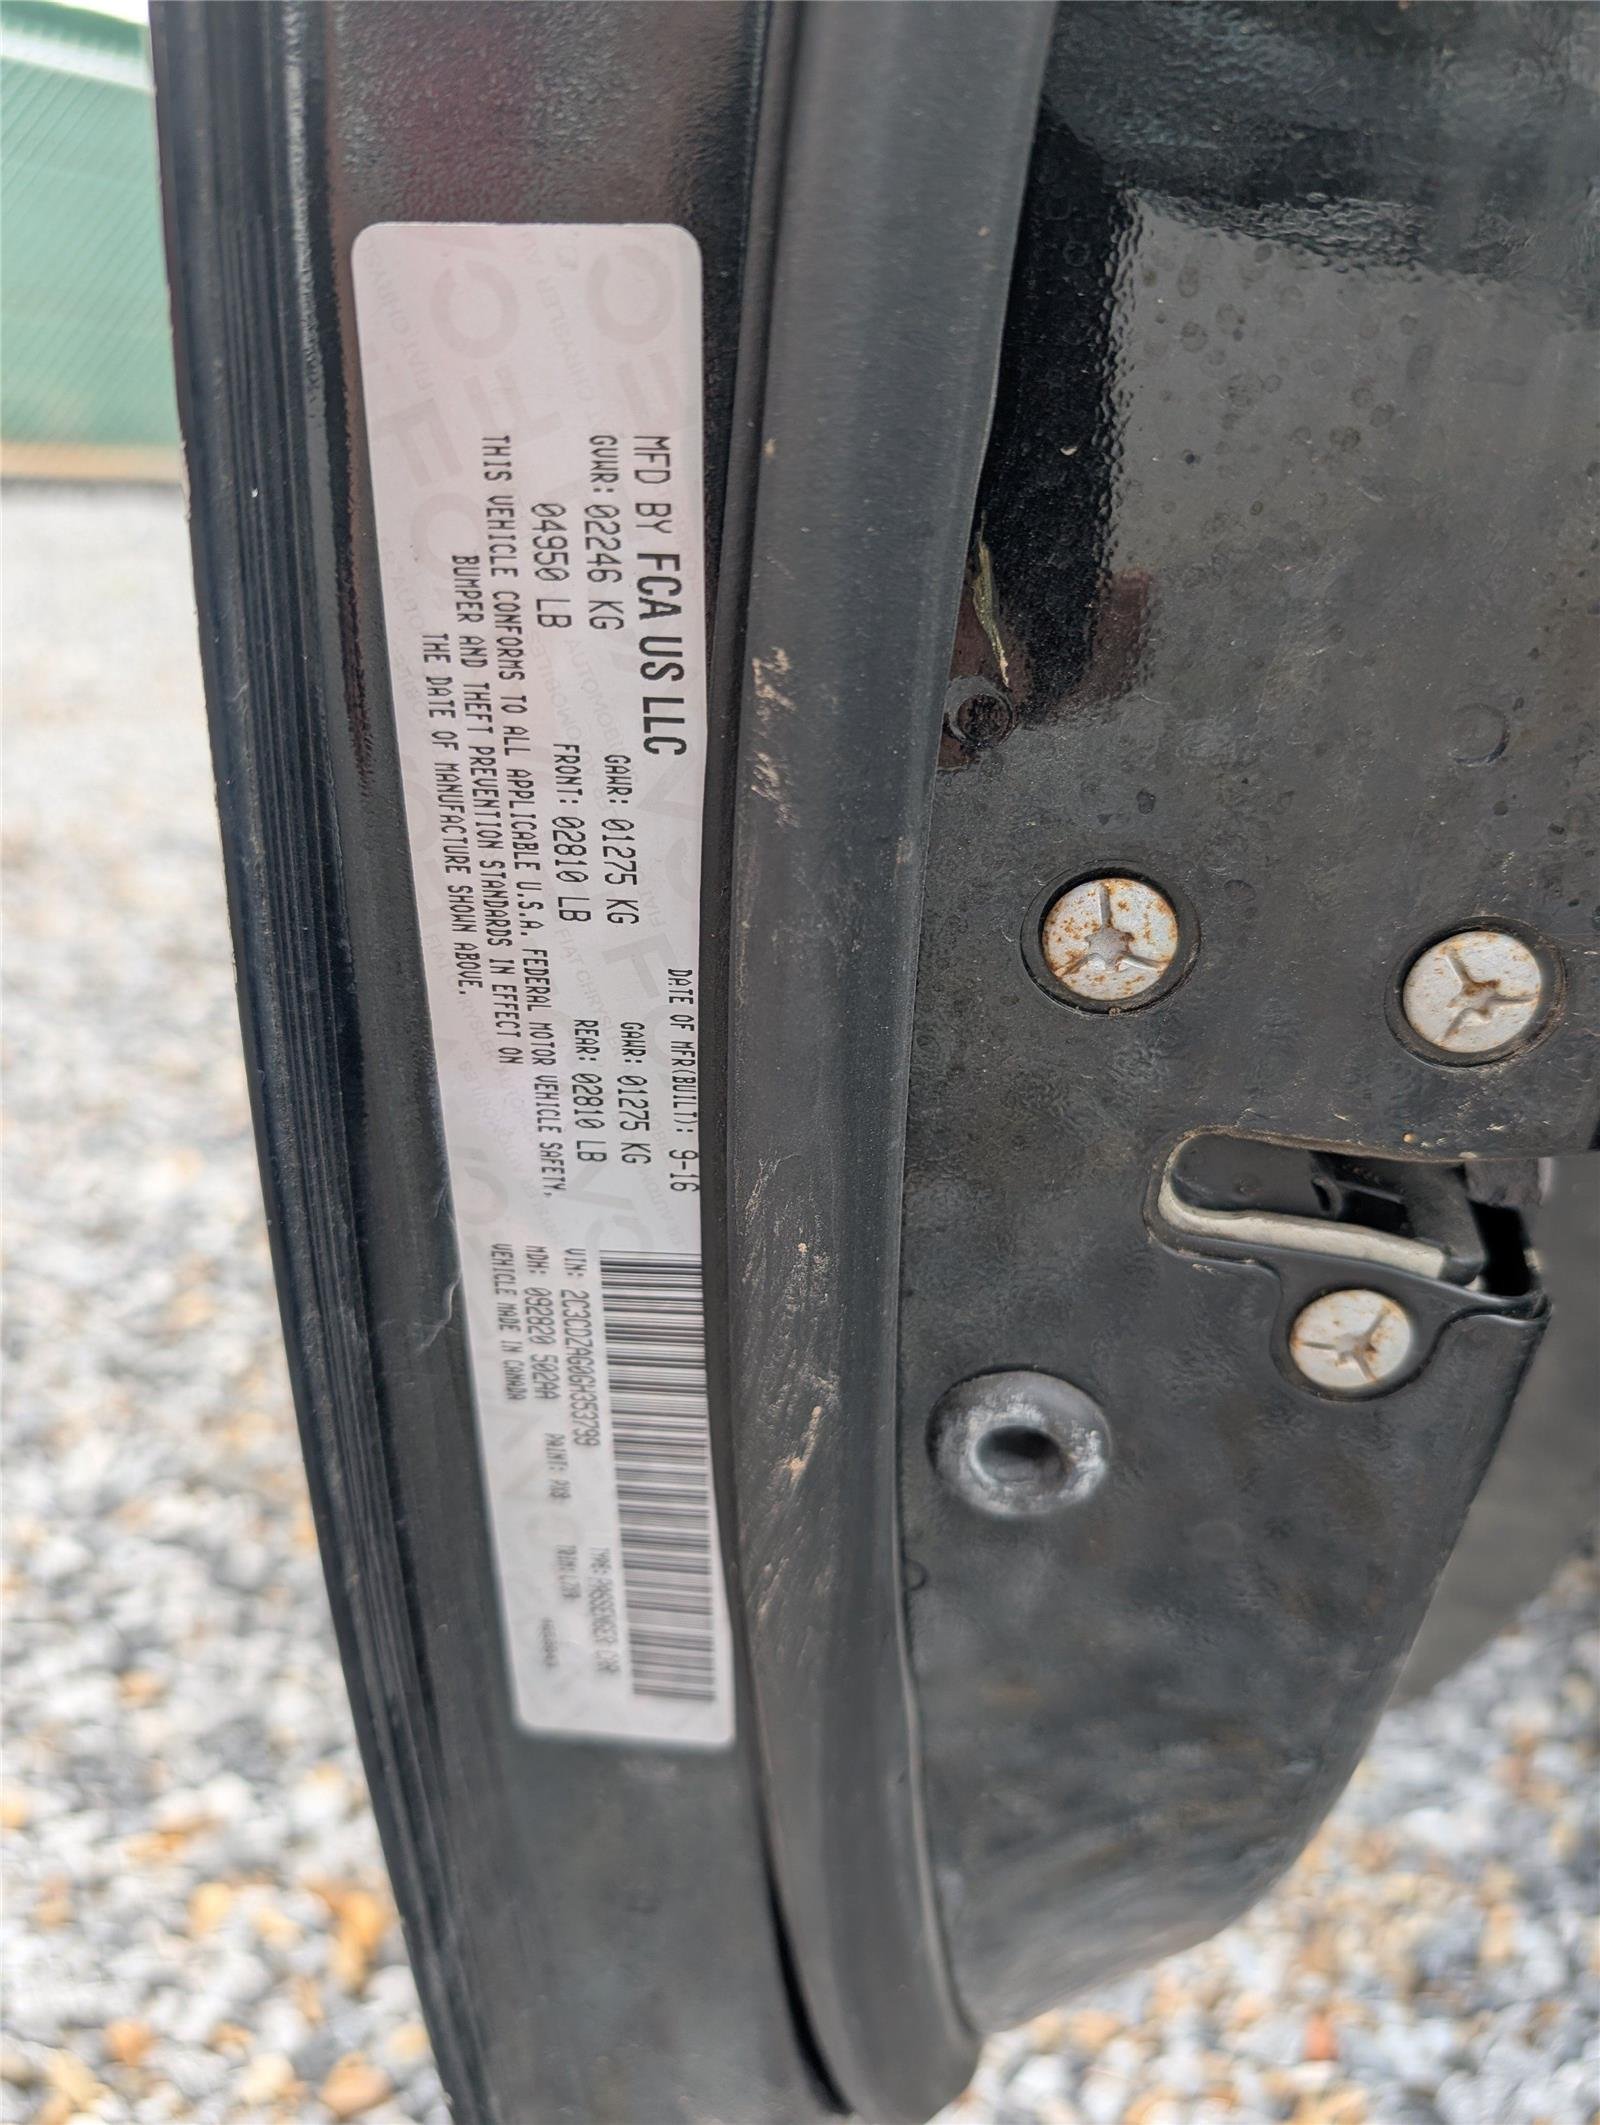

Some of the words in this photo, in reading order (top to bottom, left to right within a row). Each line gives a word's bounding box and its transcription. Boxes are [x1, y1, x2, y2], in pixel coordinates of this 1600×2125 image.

[481, 435, 510, 481] THIS
[589, 435, 618, 494] GVWR:
[633, 435, 670, 484] MFD
[486, 495, 517, 577] VEHICLE
[530, 503, 569, 582] 04950
[635, 503, 671, 534] BY
[583, 504, 621, 583] 02246
[451, 555, 482, 622] BUMPER
[636, 552, 682, 620] FCA
[493, 590, 526, 680] CONFORMS
[536, 599, 571, 628] LB
[588, 600, 624, 630] KG
[421, 633, 449, 663] THE
[459, 635, 487, 668] AND
[639, 636, 684, 681] US
[424, 676, 452, 718] DATE
[463, 682, 494, 734] THEFT
[499, 695, 526, 714] TO
[430, 731, 457, 751] OF
[502, 726, 529, 756] ALL
[643, 696, 686, 756] LLC
[468, 746, 503, 849] PREVENTION
[552, 744, 583, 804] FRONT:
[603, 755, 633, 805] GAWR:
[433, 762, 470, 874] MANUFACTURE
[505, 769, 539, 870] APPLICABLE
[551, 816, 586, 883] 02810
[601, 818, 637, 885] 01275
[446, 885, 475, 932] SHOWN
[479, 860, 512, 946] STANDARDS
[514, 882, 542, 936] U.S.A.
[557, 896, 590, 922] LB
[606, 898, 639, 925] KG
[453, 943, 483, 995] ABOVE.
[488, 958, 514, 974] IN
[522, 949, 552, 1012] FEDERAL
[667, 969, 693, 1004] DATE
[491, 983, 521, 1038] EFFECT
[669, 1014, 694, 1031] OF
[497, 1047, 523, 1064] ON
[529, 1022, 555, 1065] MOTOR
[573, 1020, 598, 1062] REAR:
[619, 1022, 646, 1064] GAWR:
[534, 1075, 562, 1133] VEHICLE
[571, 1073, 603, 1129] 02810
[616, 1075, 649, 1131] 01275
[670, 1040, 698, 1133] MFR(BUILT):
[576, 1140, 606, 1162] LB
[620, 1143, 650, 1164] KG
[669, 1149, 698, 1192] 9-16
[489, 1243, 520, 1295] VEHICLE
[523, 1245, 547, 1274] MDH:
[561, 1247, 587, 1277] VIN:
[495, 1302, 525, 1331] MADE
[524, 1287, 556, 1344] 092820
[500, 1341, 523, 1353] IN
[561, 1289, 600, 1447] 2C3CDZAG0GH353799
[500, 1360, 526, 1400] CANADA
